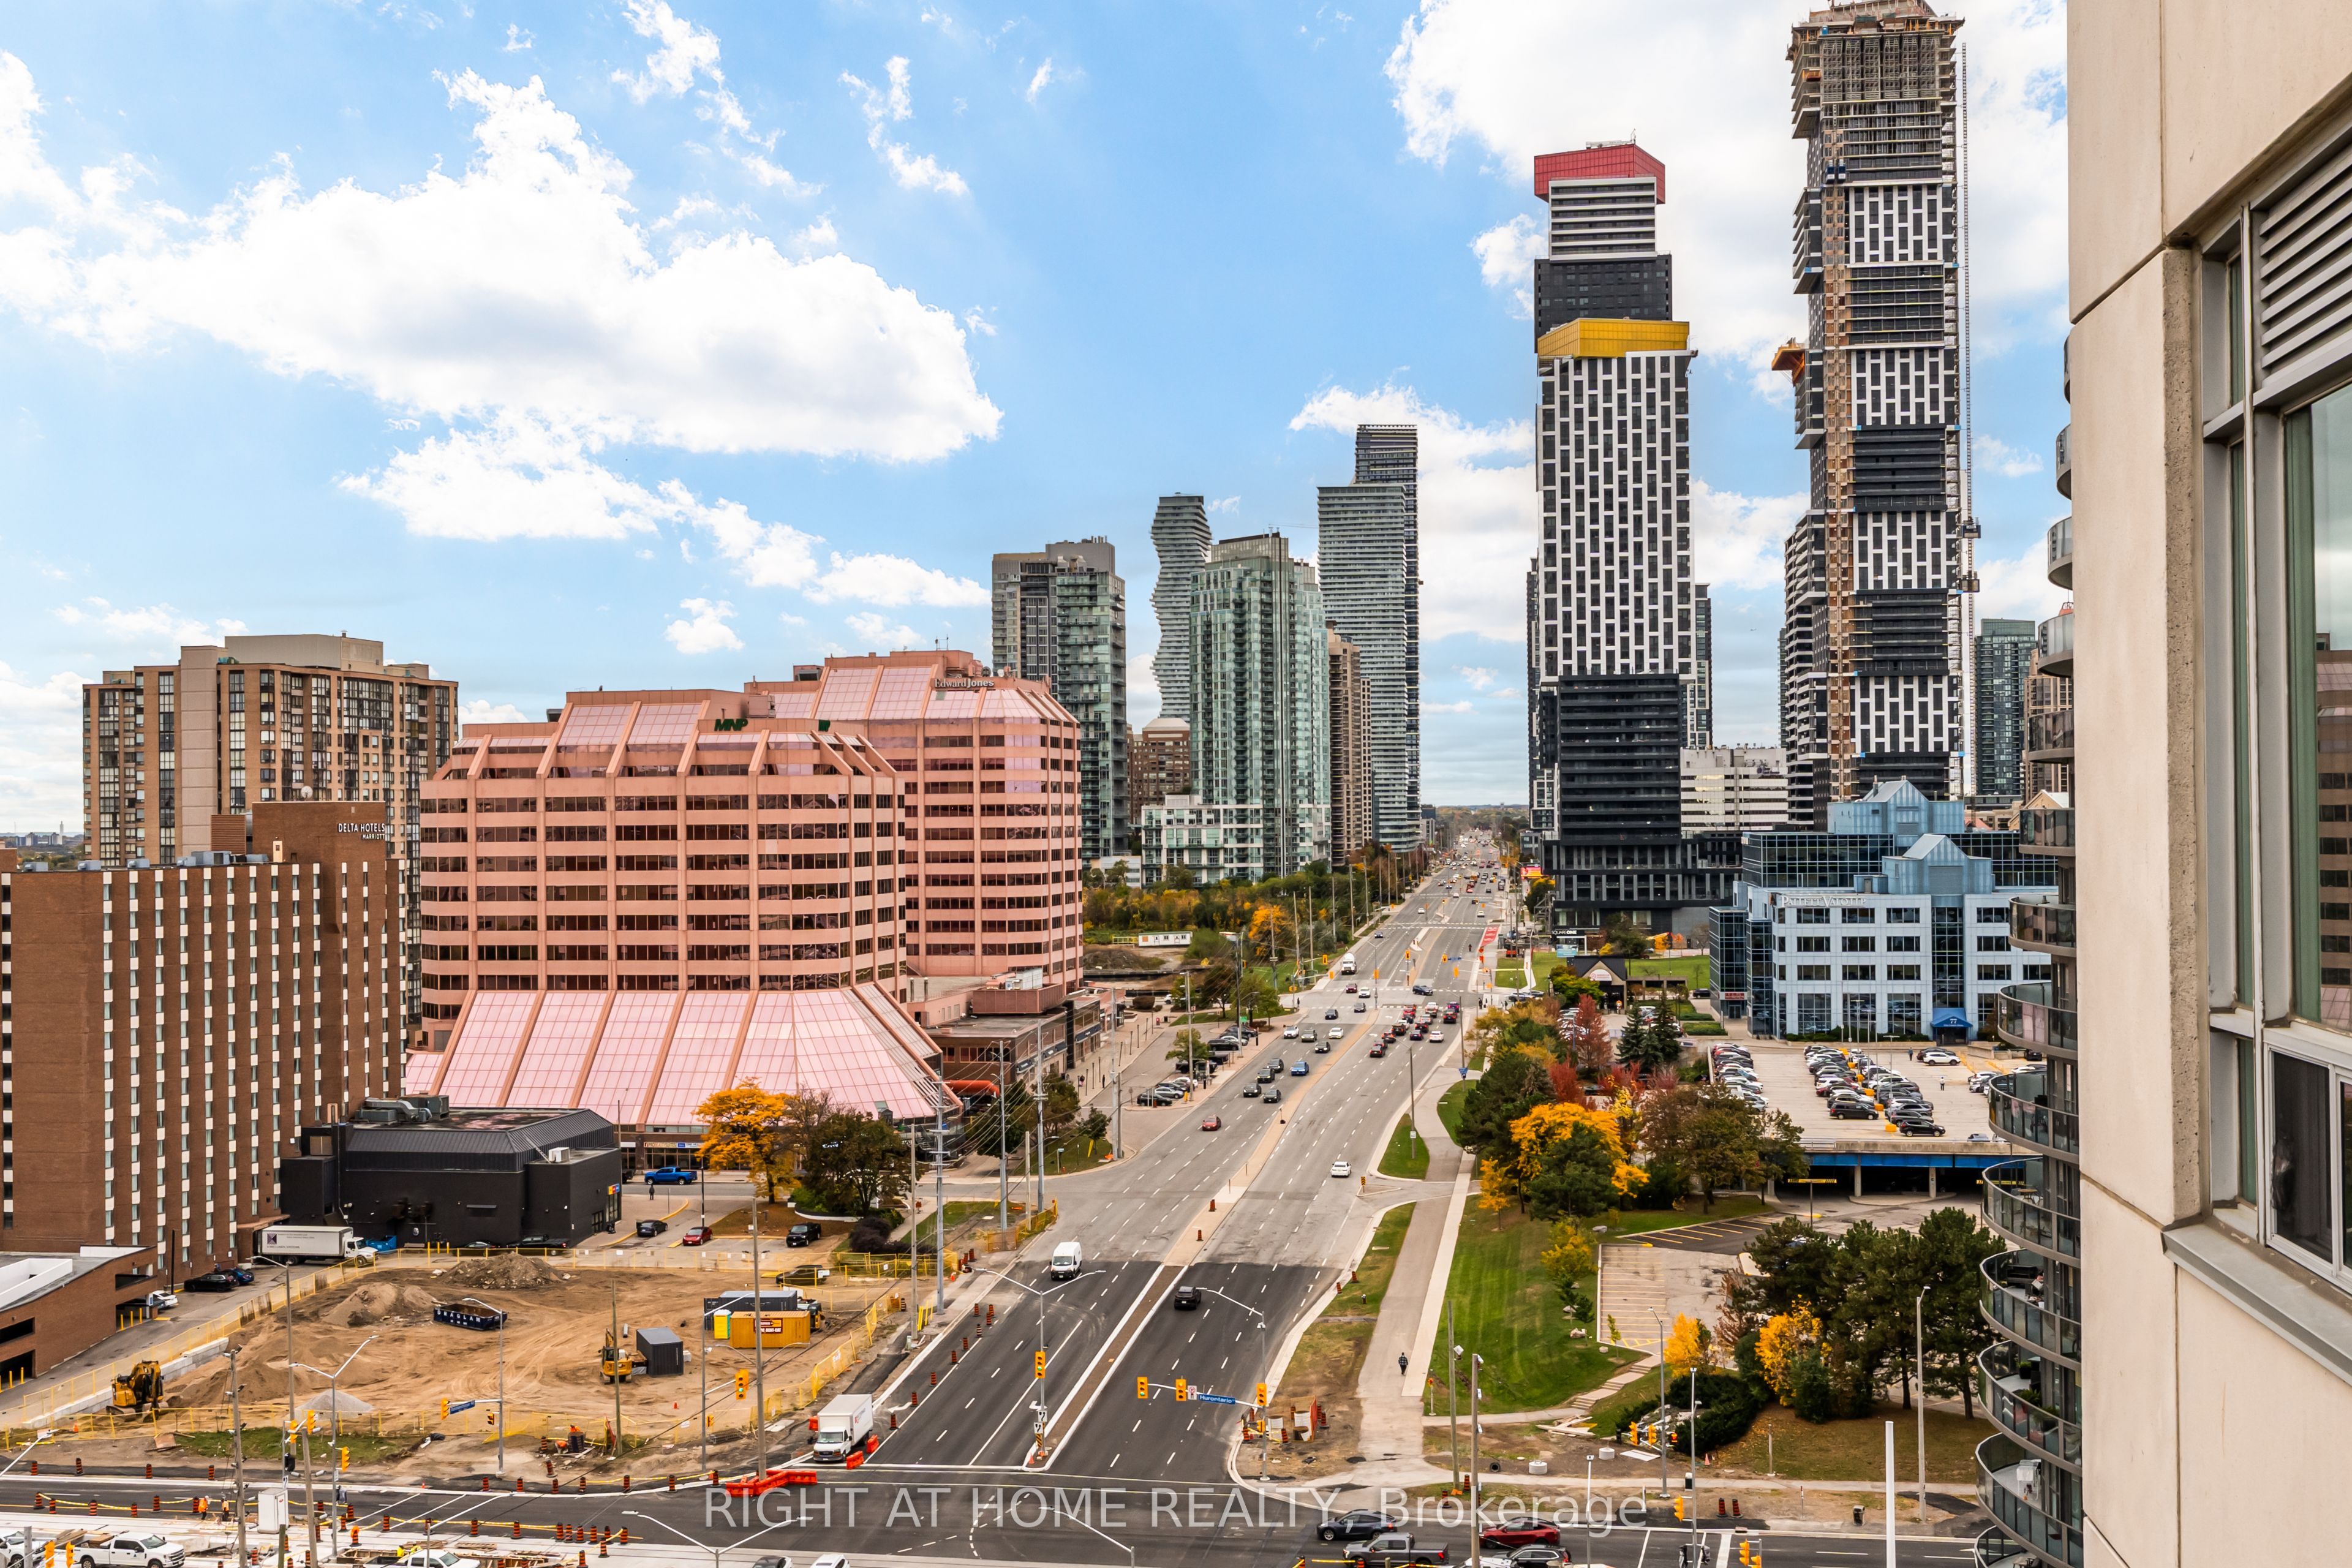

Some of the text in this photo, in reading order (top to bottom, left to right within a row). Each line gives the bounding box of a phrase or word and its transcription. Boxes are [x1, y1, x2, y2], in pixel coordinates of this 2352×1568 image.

[714, 718, 748, 731] MNP
[338, 823, 385, 832] DELTA HOTELS
[1199, 1395, 1232, 1403] Hurontario
